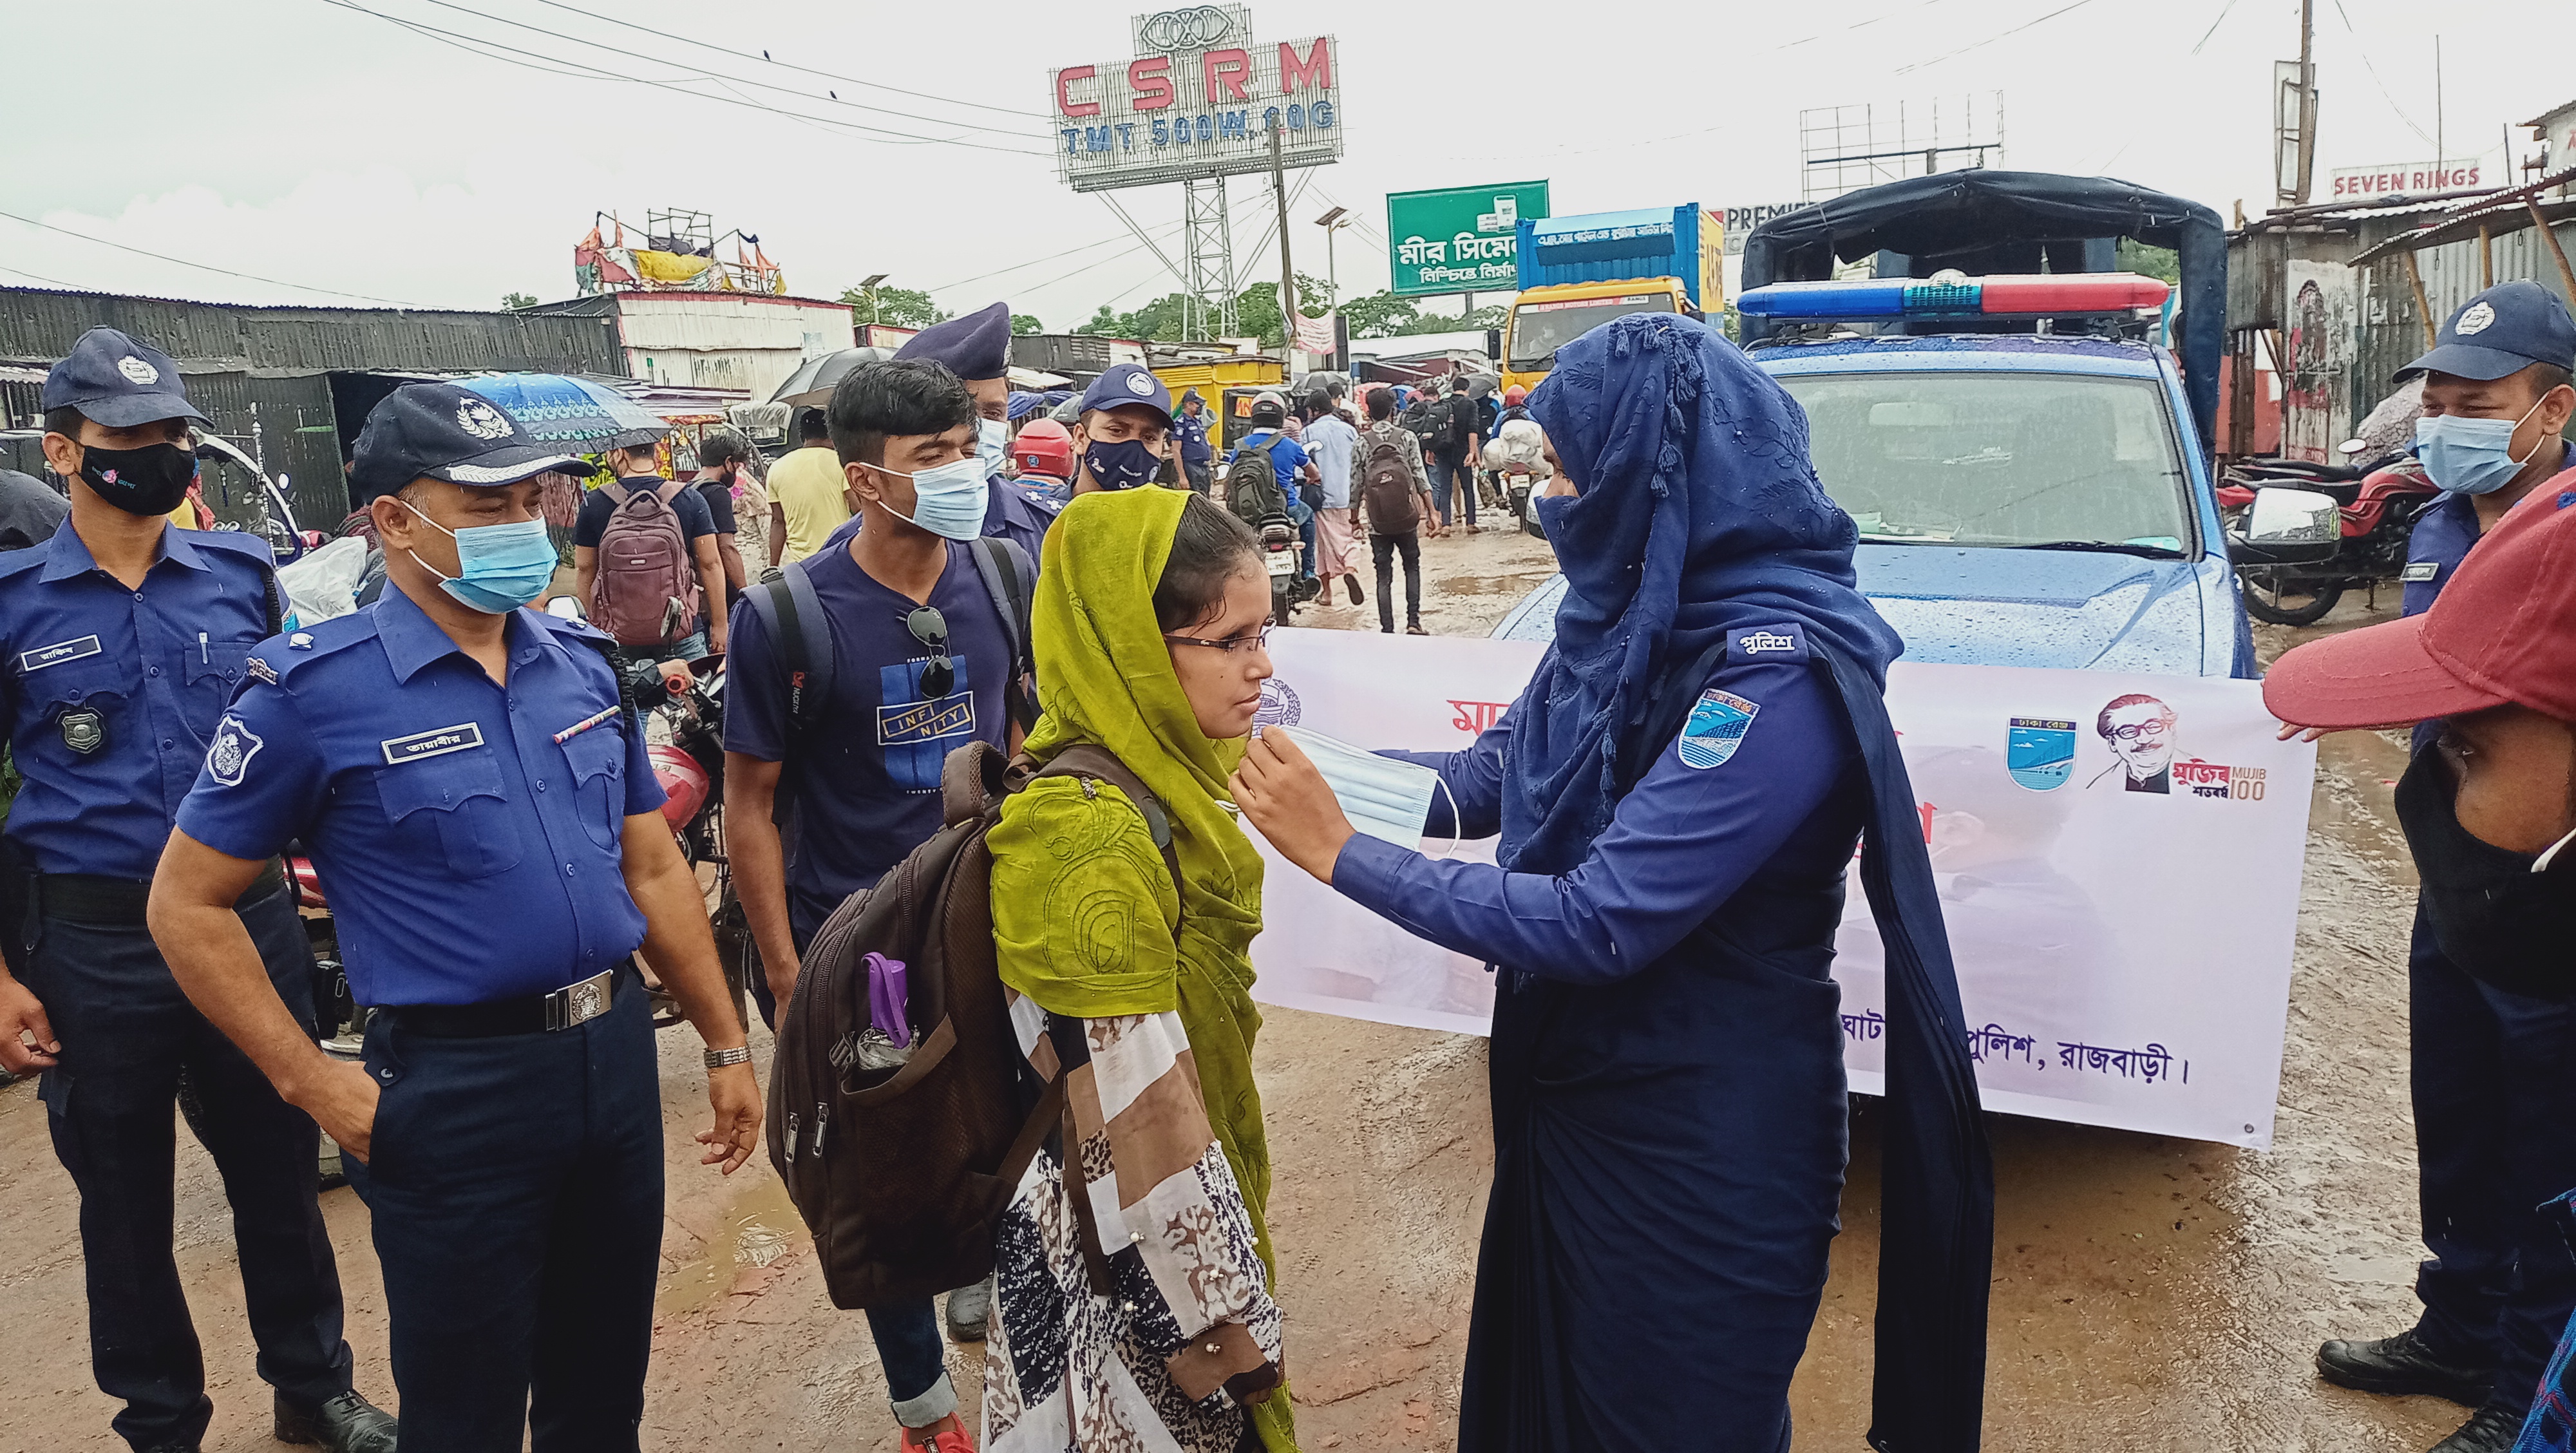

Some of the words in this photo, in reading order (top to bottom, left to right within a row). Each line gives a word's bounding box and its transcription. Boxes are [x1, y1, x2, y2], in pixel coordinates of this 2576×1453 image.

[1057, 37, 1331, 117] CSRM
[1061, 122, 1135, 155] TMT
[2334, 172, 2405, 195] SEVEN
[2412, 167, 2480, 191] RINGS
[1396, 235, 1448, 265] মীর
[1452, 231, 1517, 261] সিমে
[1739, 631, 1795, 654] পুলিশ
[1446, 699, 1511, 737] মা
[2018, 719, 2042, 728] ঢাকা
[2172, 758, 2230, 786] মুজিব
[2231, 766, 2267, 780] MUJIB
[2230, 779, 2266, 801] 100
